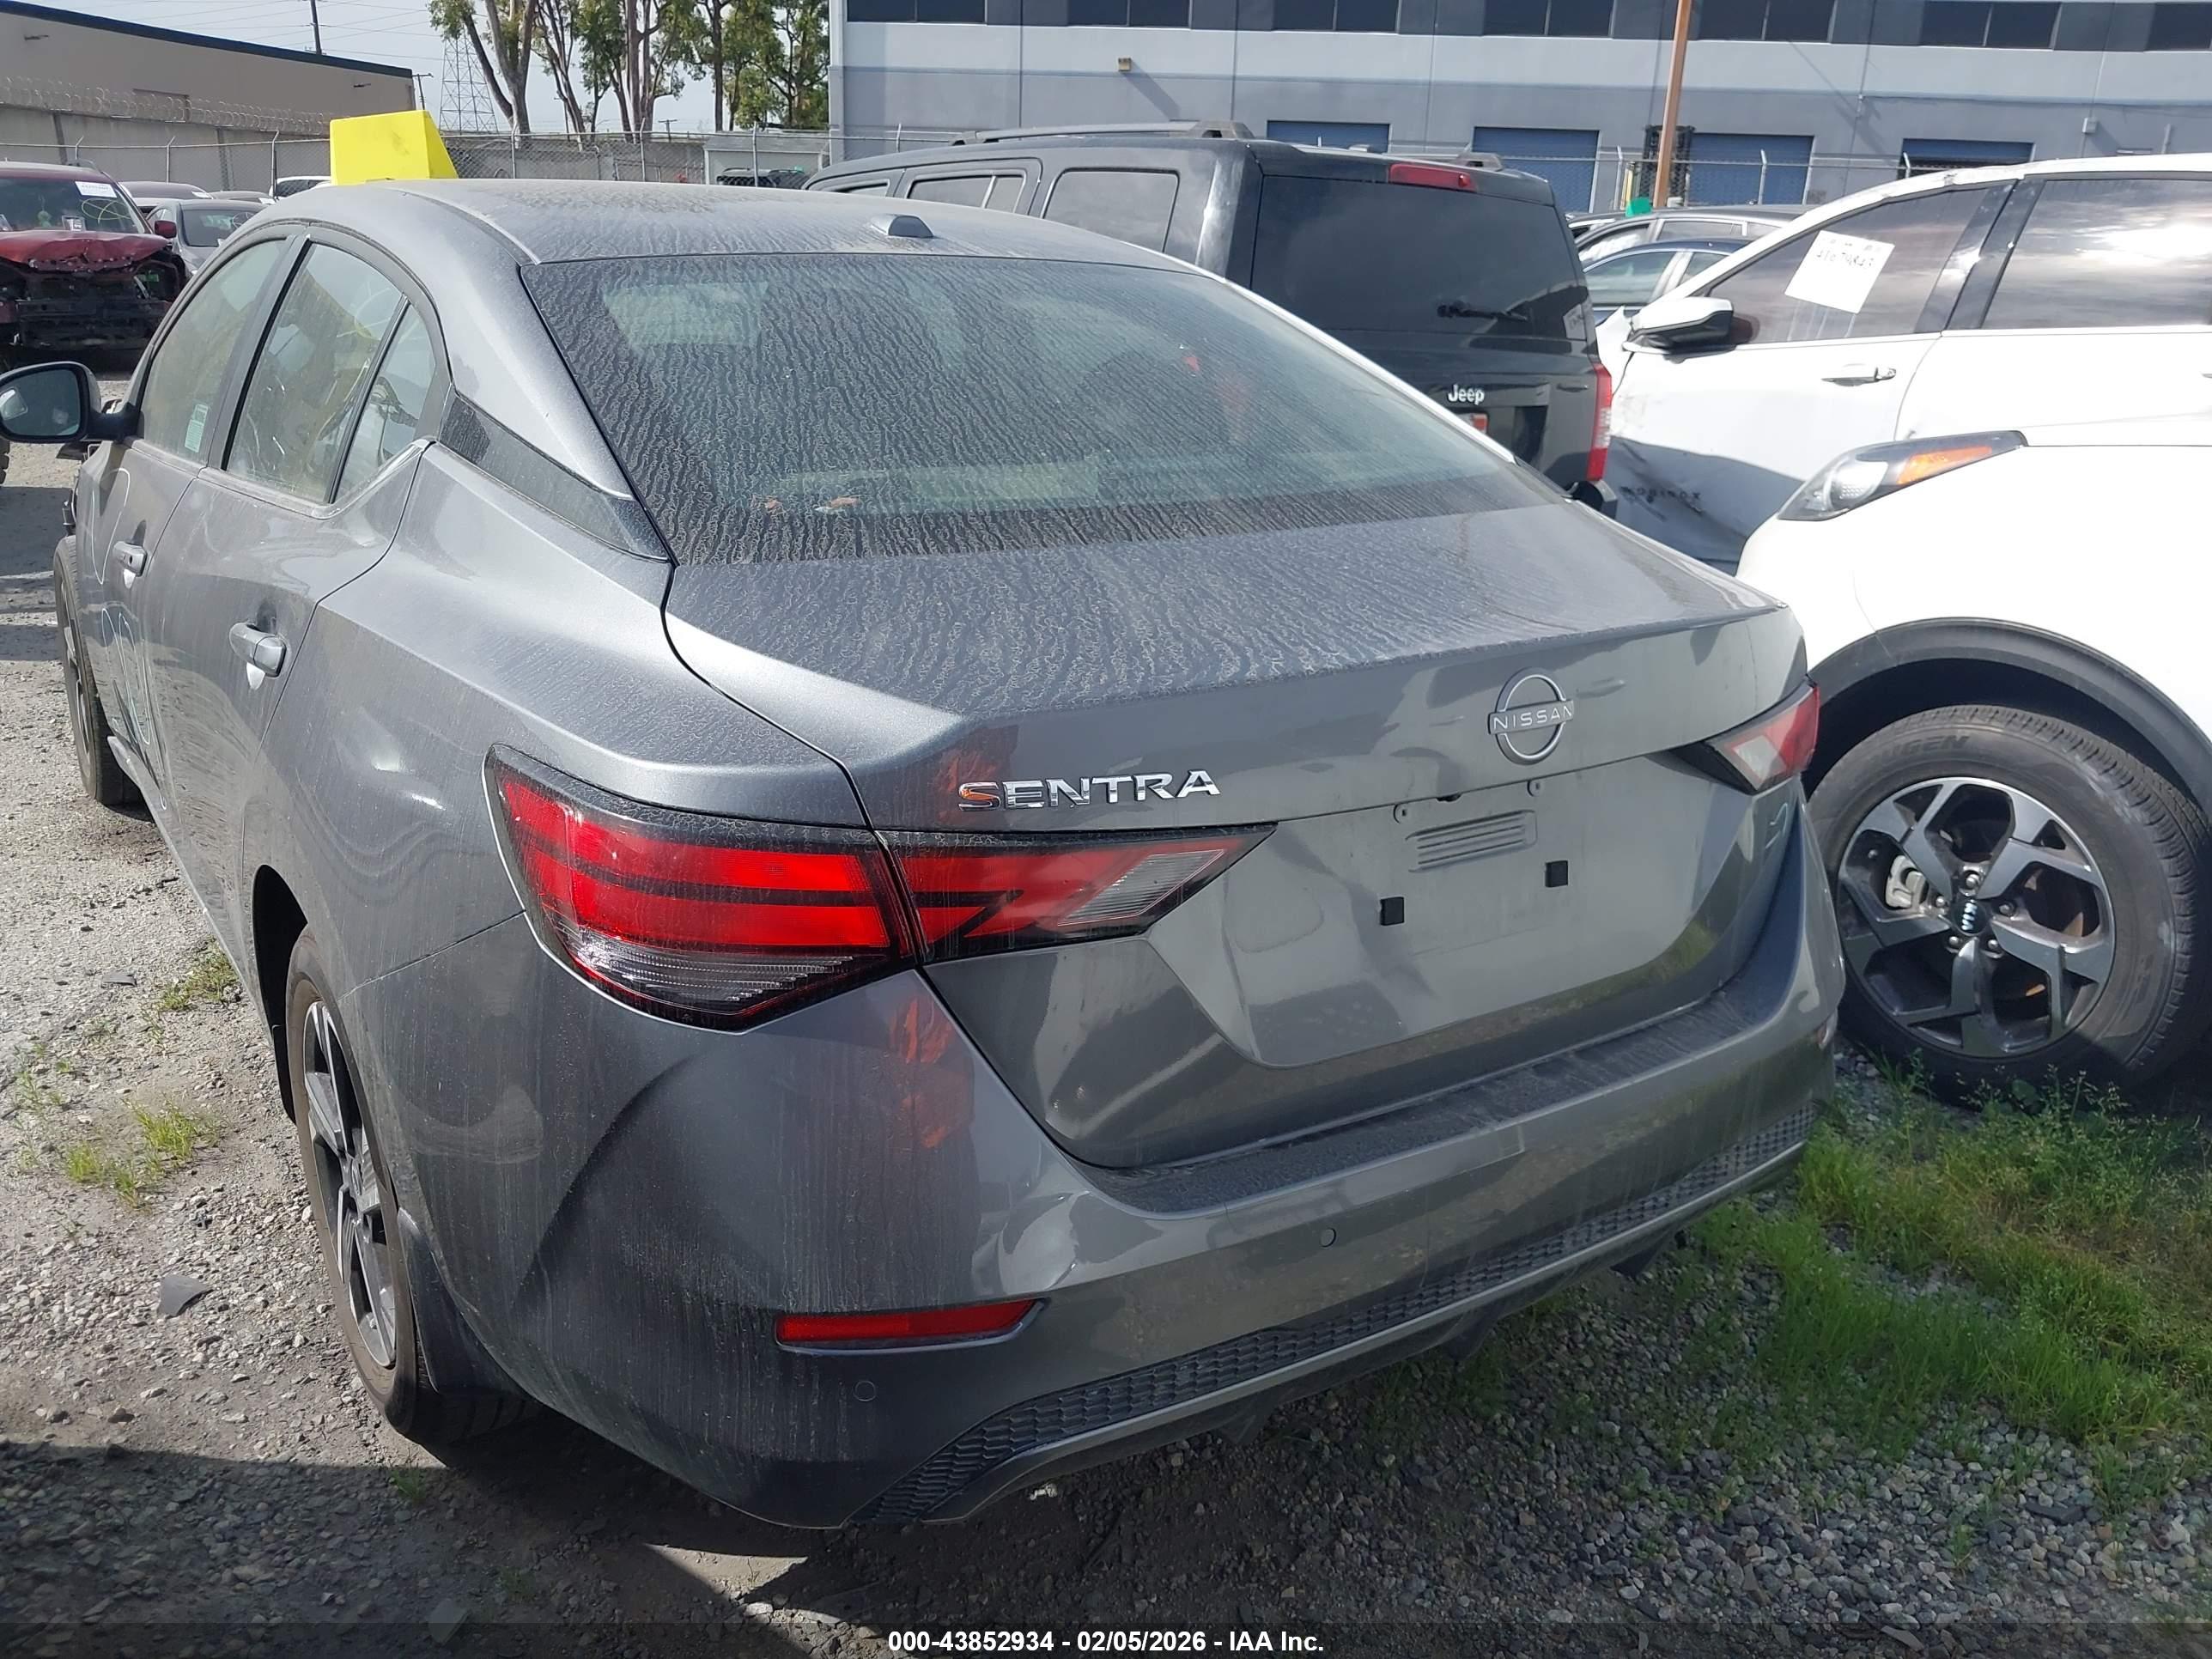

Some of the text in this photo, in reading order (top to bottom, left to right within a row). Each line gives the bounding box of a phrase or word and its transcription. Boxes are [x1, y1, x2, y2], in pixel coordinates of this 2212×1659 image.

[1448, 384, 1486, 405] Jeep
[1492, 704, 1573, 731] NISSAN
[957, 769, 1221, 811] SENTRA
